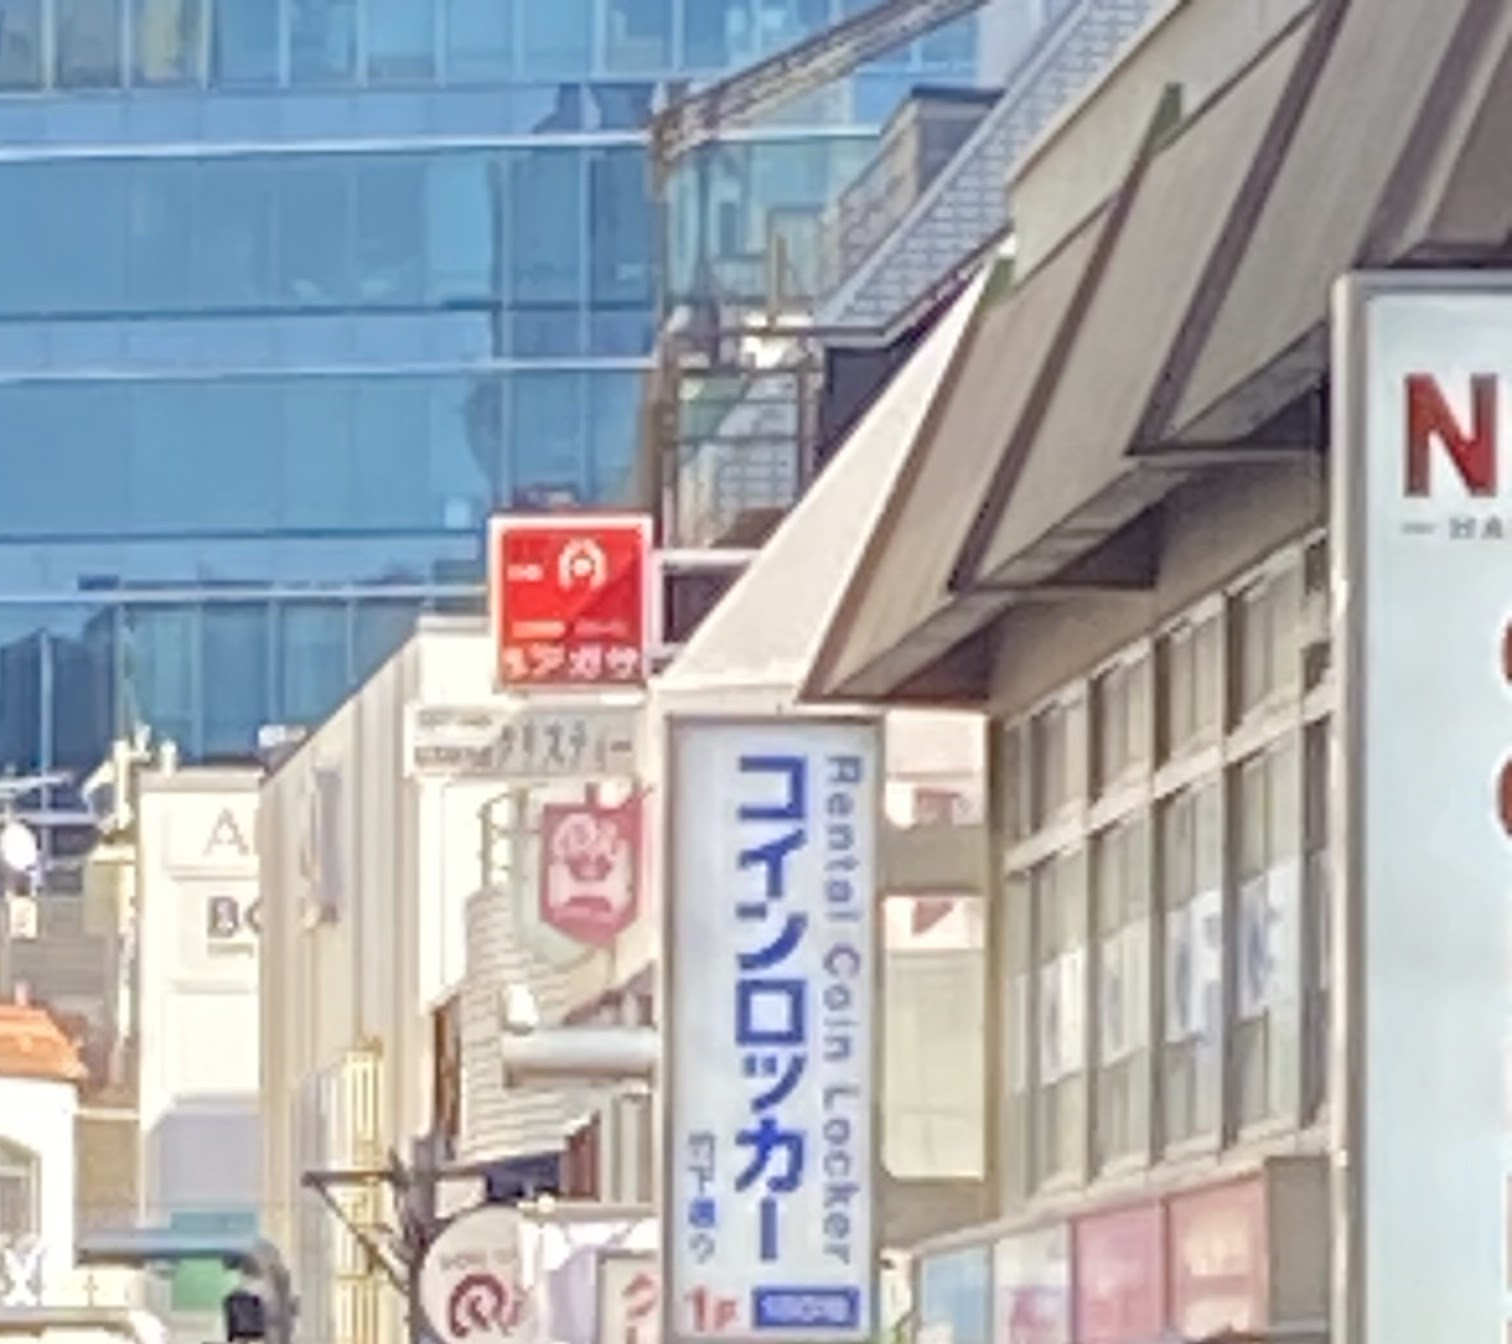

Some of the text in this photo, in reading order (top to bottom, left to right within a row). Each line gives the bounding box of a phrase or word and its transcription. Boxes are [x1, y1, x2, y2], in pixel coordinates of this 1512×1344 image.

[734, 754, 808, 1263] コインロッカー
[822, 755, 865, 1265] Rental Coin Locker
